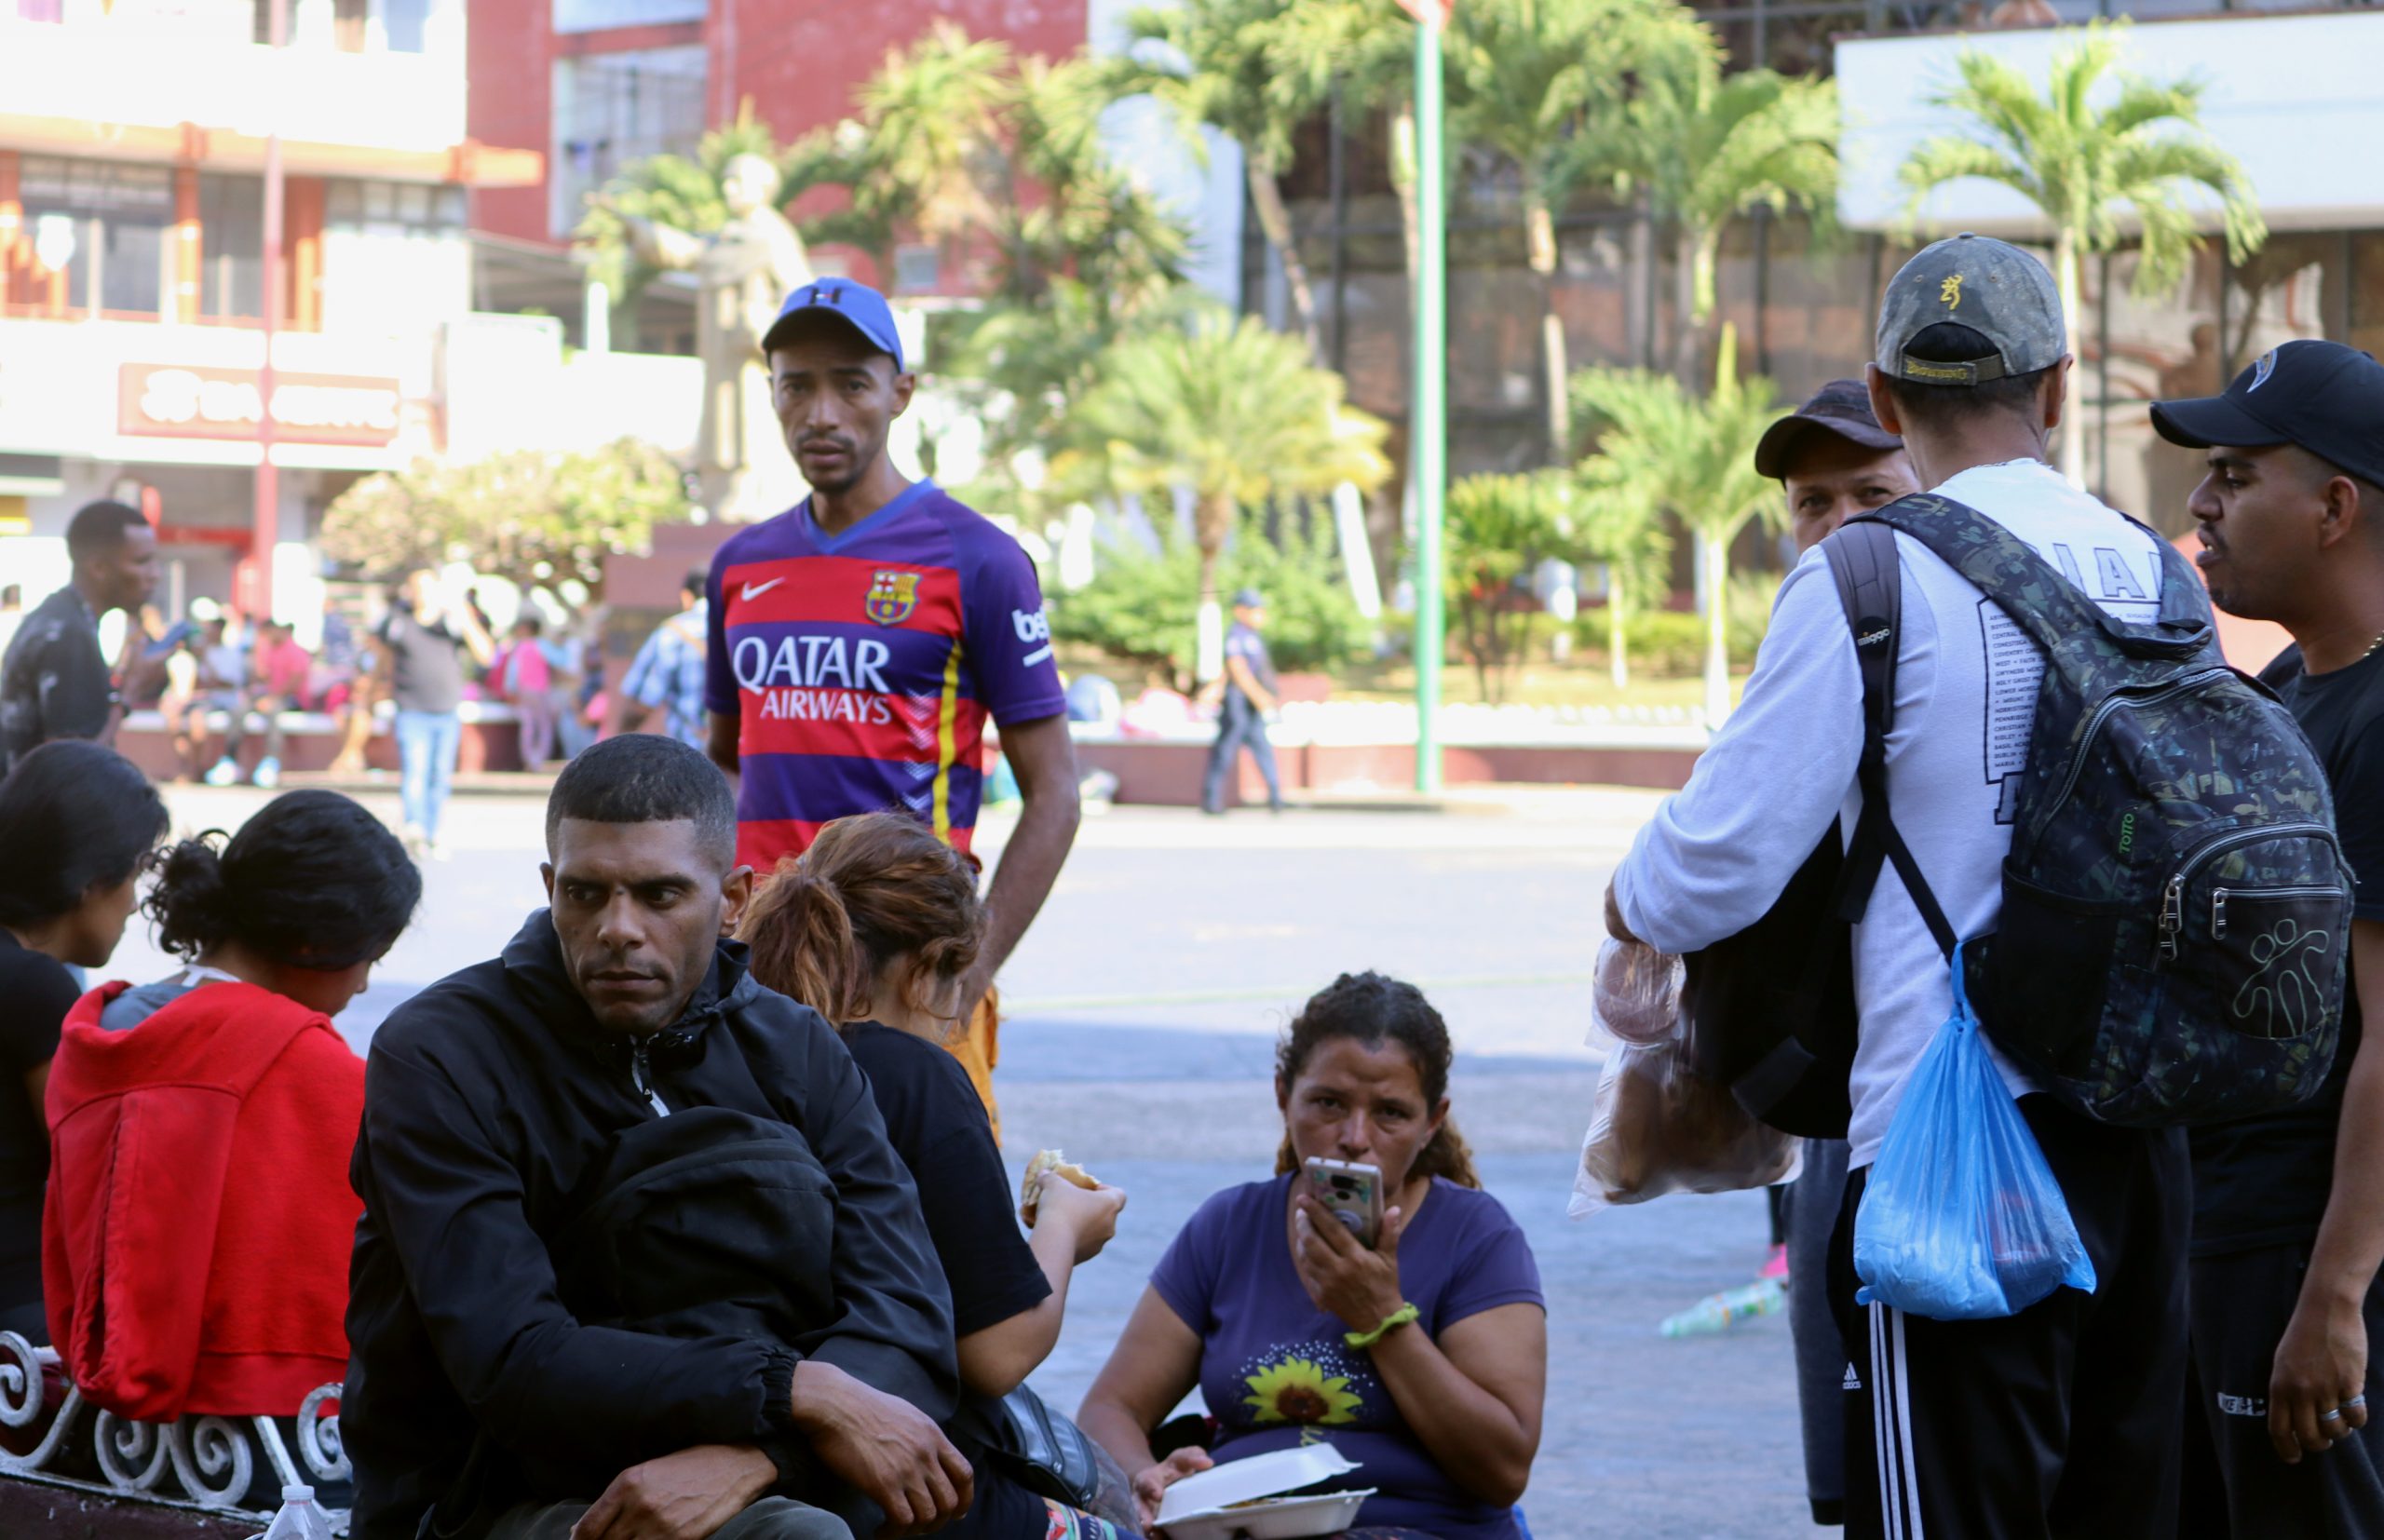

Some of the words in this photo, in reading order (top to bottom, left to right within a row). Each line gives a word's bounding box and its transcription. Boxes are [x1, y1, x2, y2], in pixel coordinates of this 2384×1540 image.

[733, 636, 890, 696] QATAR
[760, 689, 892, 725] AIRWAYS
[2119, 813, 2134, 855] TOTTO
